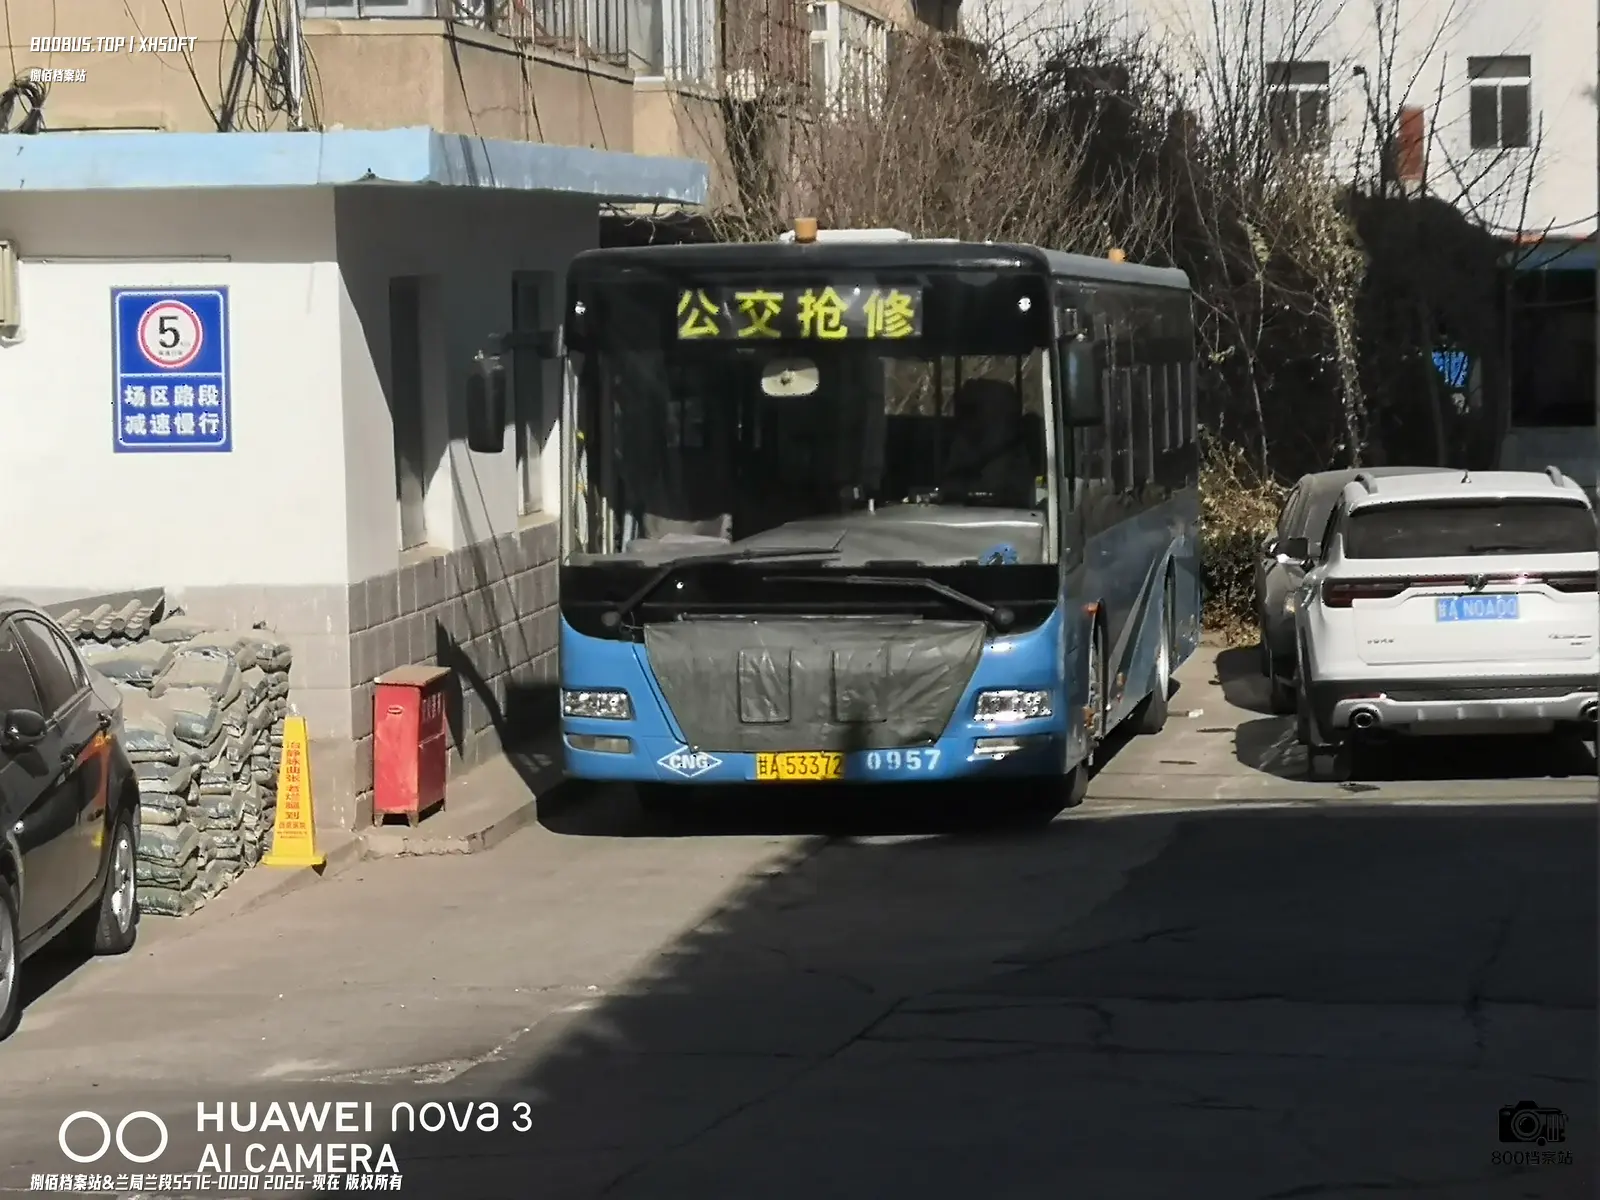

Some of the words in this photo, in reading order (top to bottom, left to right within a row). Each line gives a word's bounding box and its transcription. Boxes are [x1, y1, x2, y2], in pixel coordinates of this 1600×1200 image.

[676, 285, 915, 339] 公交抢修
[158, 315, 181, 348] 5
[124, 384, 219, 407] 场区路段
[124, 412, 220, 436] 减速慢行
[668, 753, 711, 770] CNG
[866, 749, 941, 771] 0957
